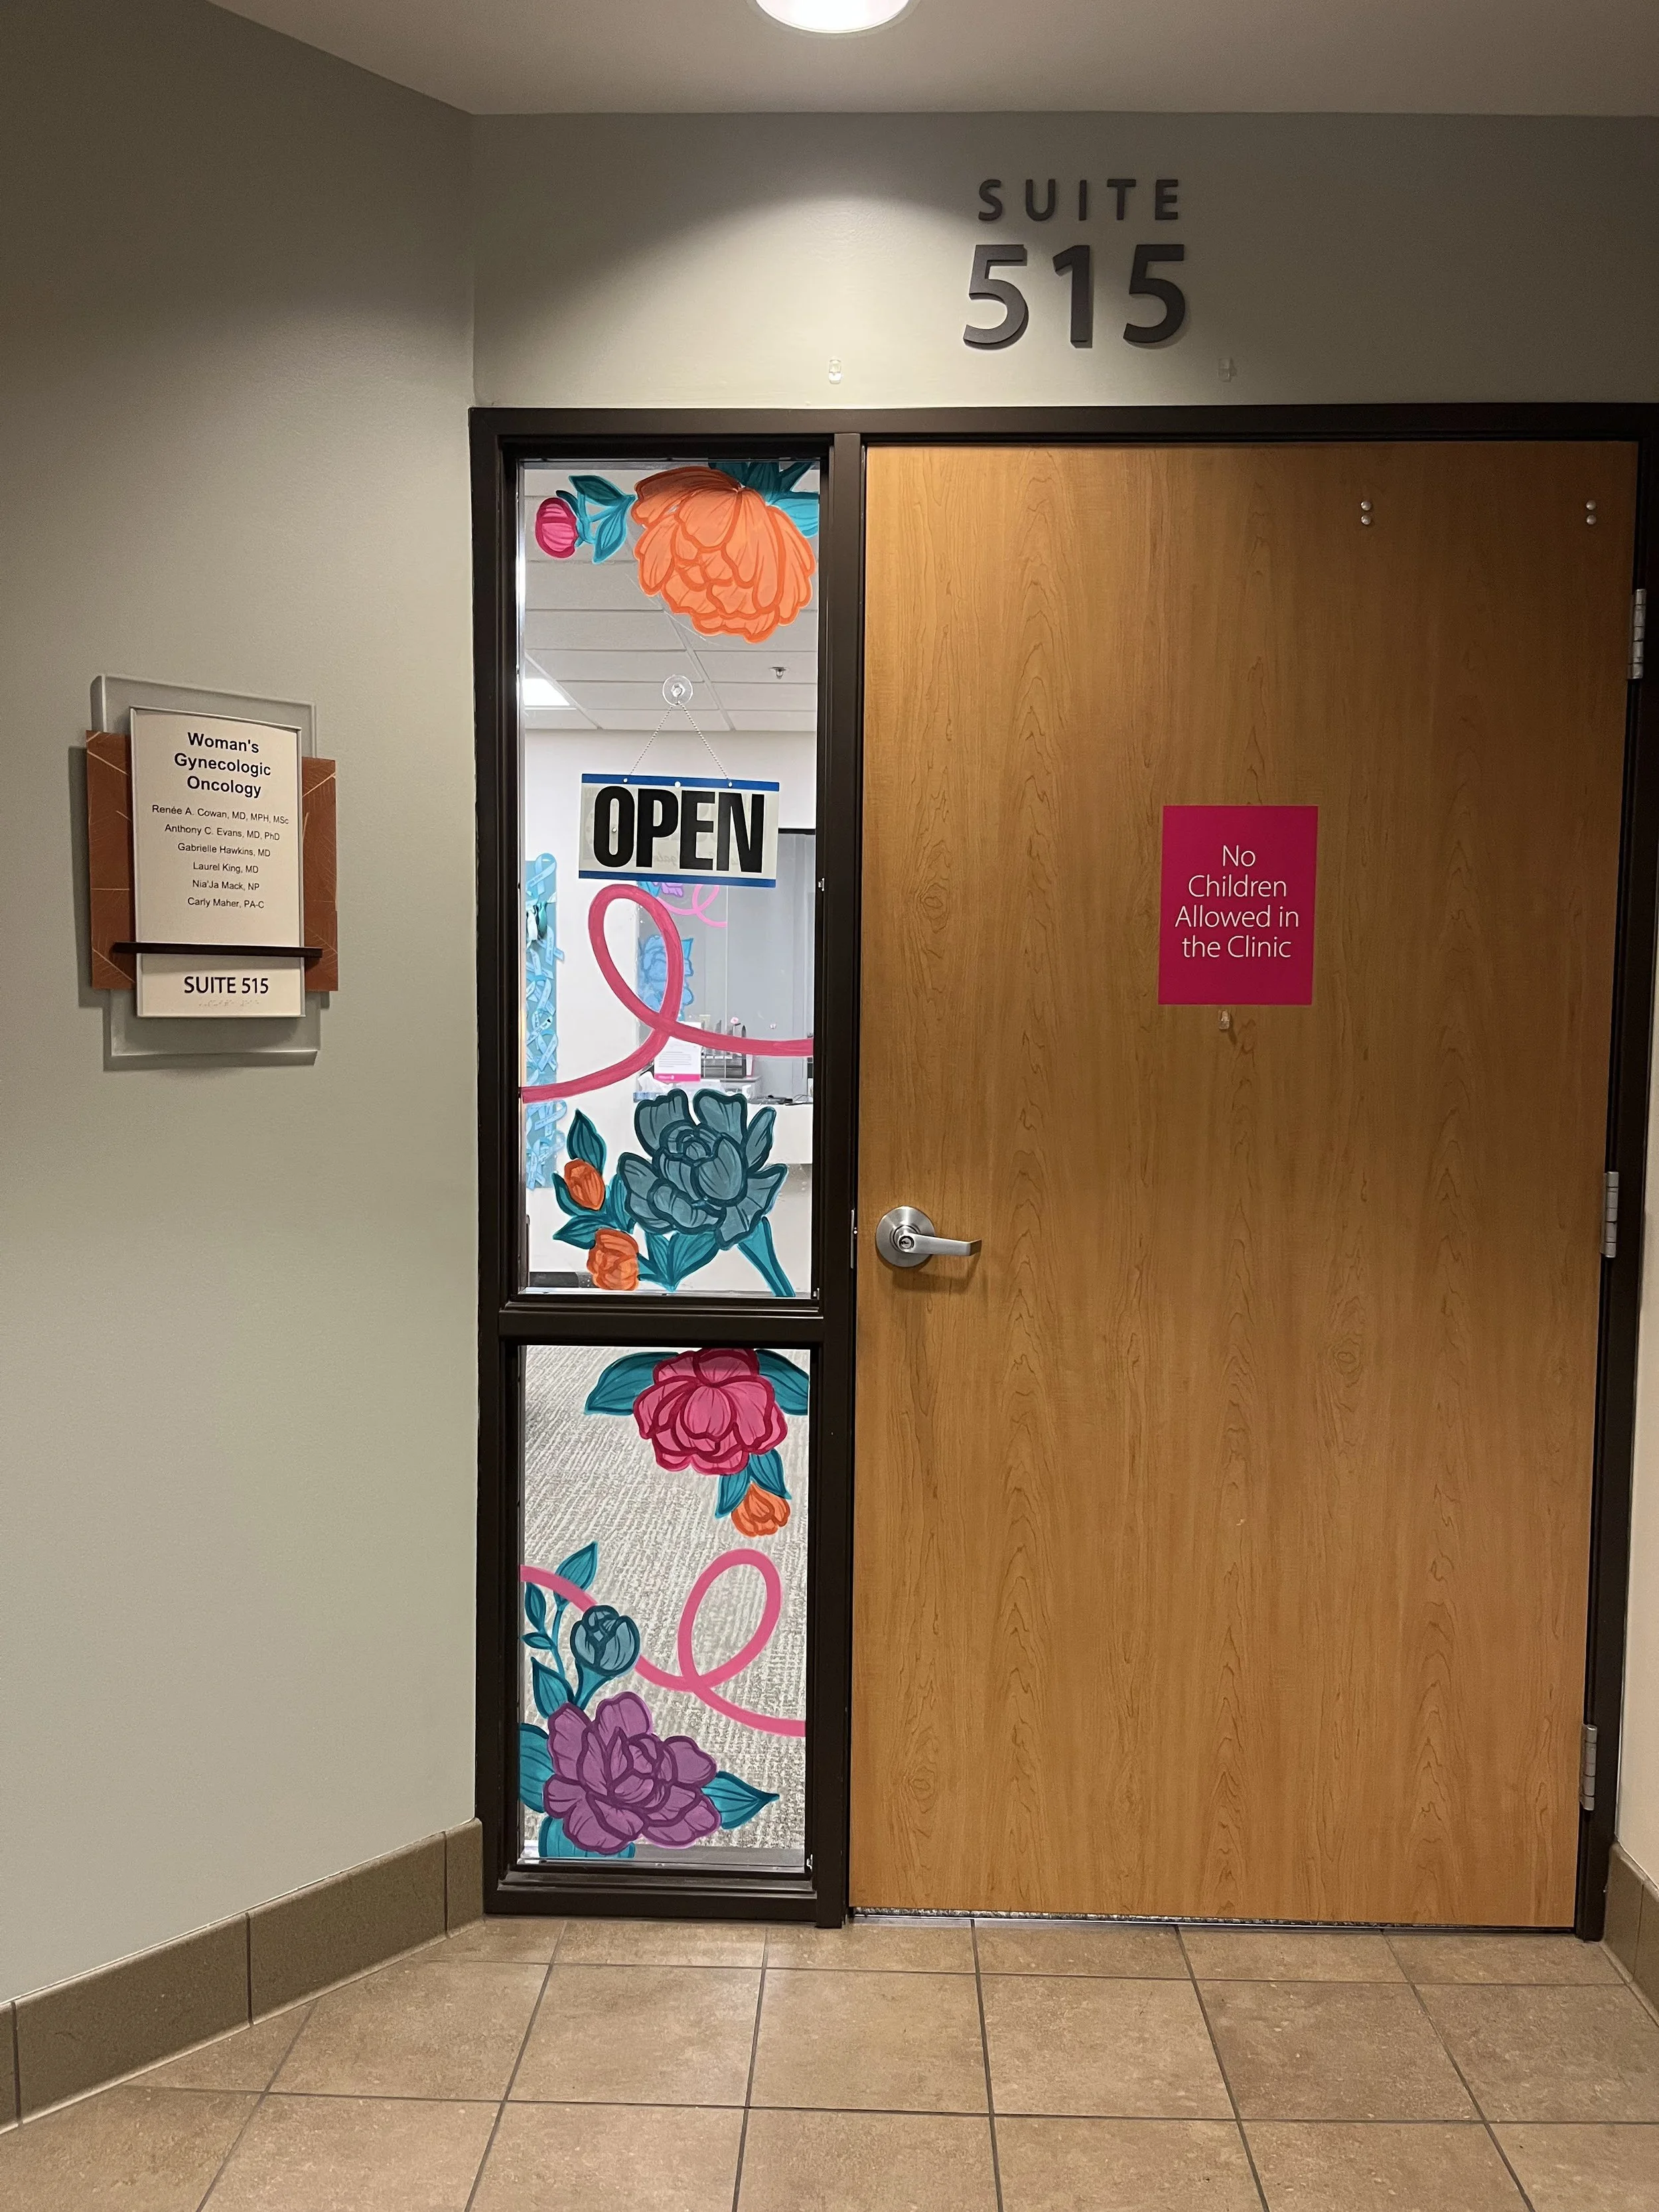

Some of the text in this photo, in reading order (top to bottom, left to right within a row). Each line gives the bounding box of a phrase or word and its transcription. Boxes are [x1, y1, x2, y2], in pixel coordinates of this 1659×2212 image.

[978, 179, 1179, 221] SUITE
[964, 244, 1186, 348] 515
[187, 731, 259, 753] Woman's
[174, 753, 271, 777] Gynecologic
[187, 775, 261, 798] Oncology
[152, 804, 289, 824] Renée A. Cowan, MD, MPH, MSc
[165, 824, 280, 841] Anthony C. Evans, MD, PhD
[593, 785, 764, 873] OPEN
[177, 842, 271, 857] Gabrielle Hawkins, MD
[1222, 845, 1256, 867] No
[193, 861, 259, 874] Laurel King, MD
[192, 879, 219, 889] Nia'Ja
[222, 881, 246, 891] Mack,
[1188, 874, 1287, 897] Children
[187, 897, 264, 909] Carly Maher, PA-C
[1175, 905, 1299, 928] Allowed in
[1182, 934, 1291, 958] the Clinic
[184, 975, 269, 995] SUITE 515
